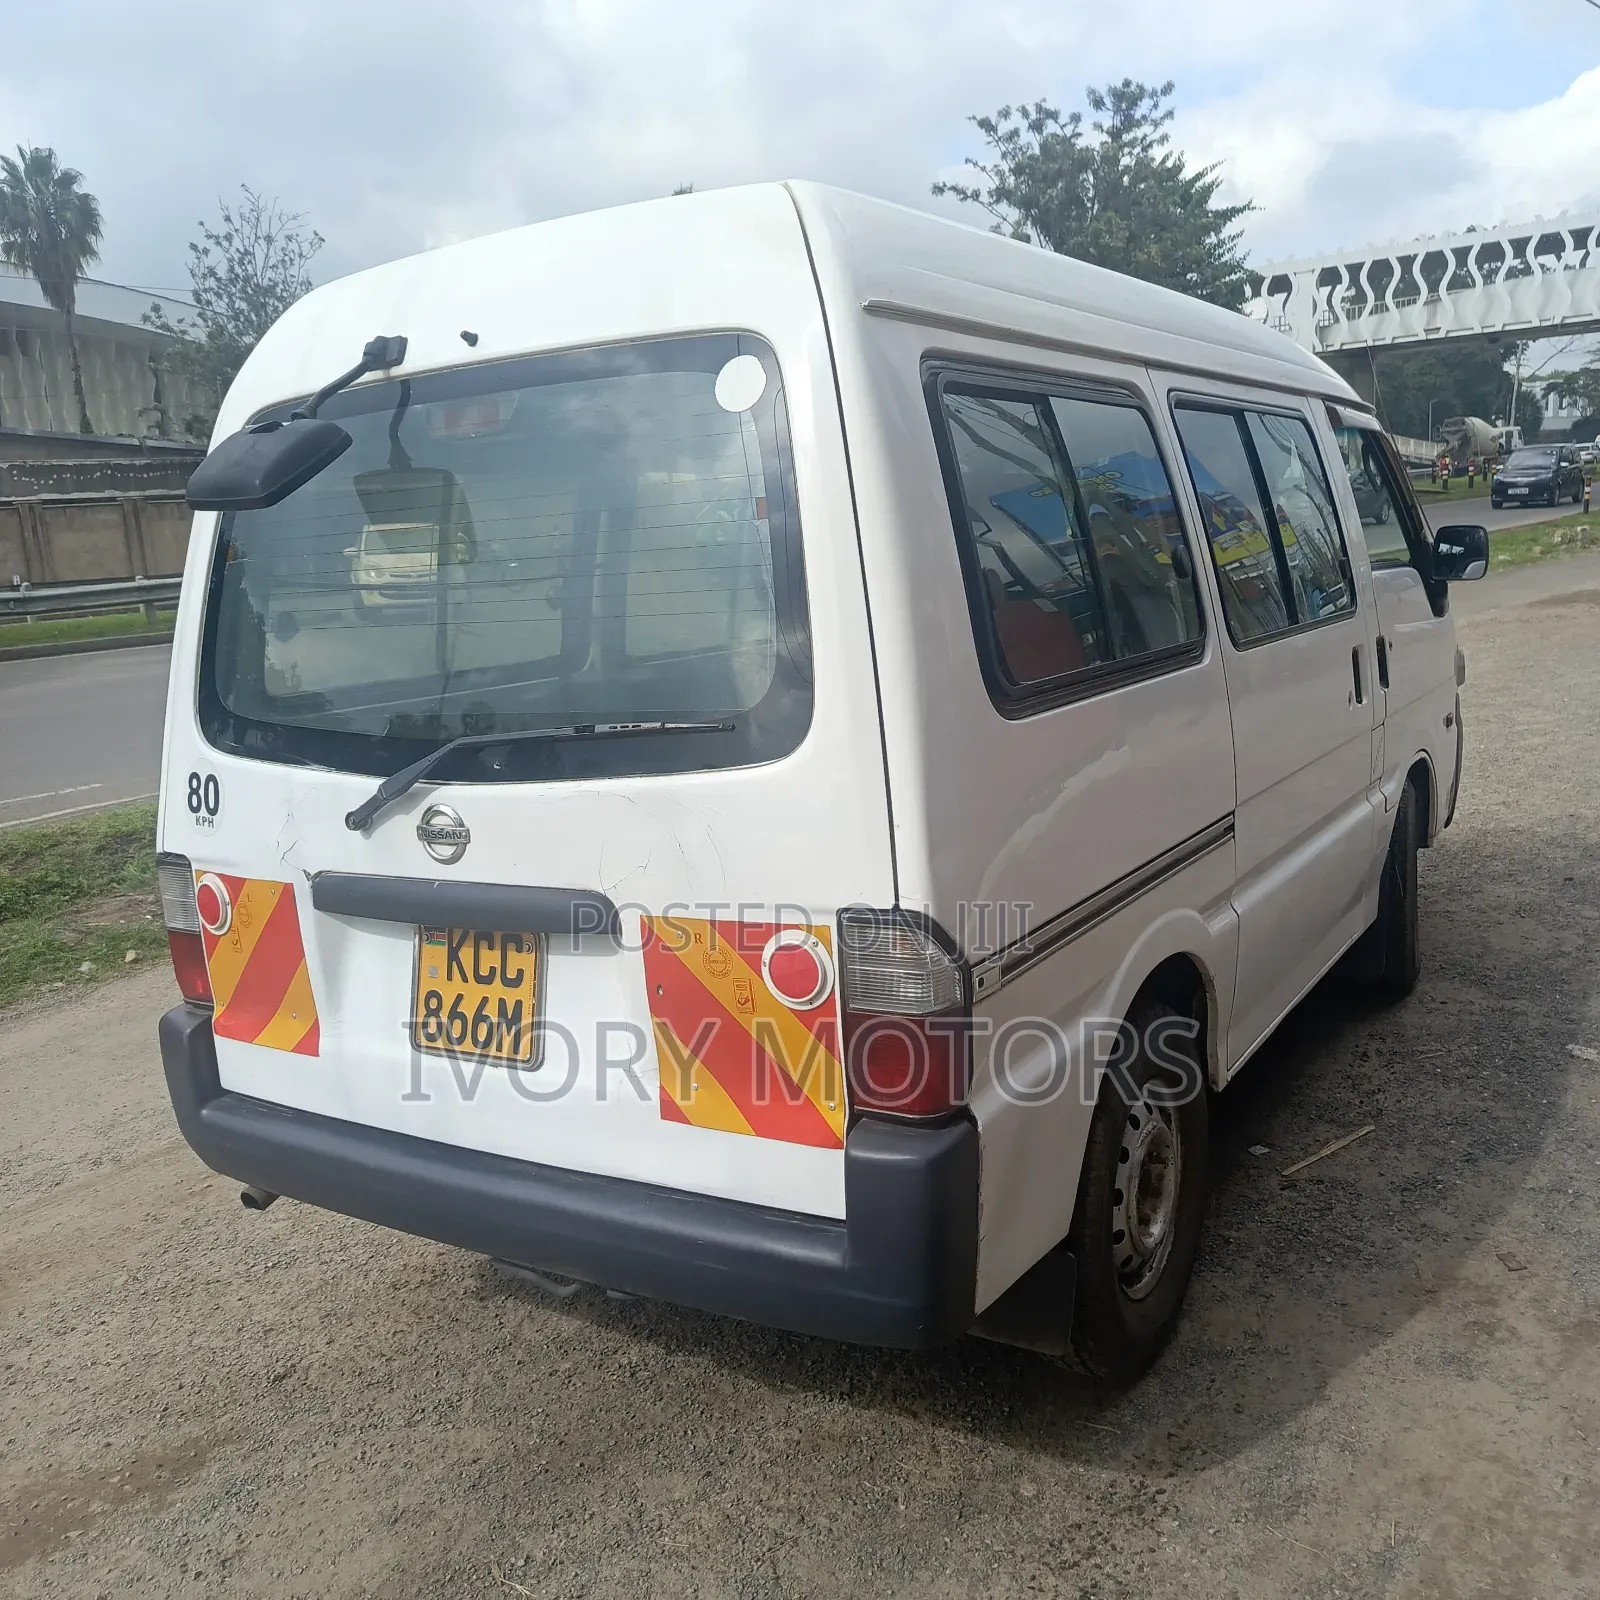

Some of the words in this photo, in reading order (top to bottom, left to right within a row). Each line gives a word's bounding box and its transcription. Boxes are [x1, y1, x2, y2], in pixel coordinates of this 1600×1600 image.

[188, 771, 220, 817] 80
[195, 815, 215, 829] KPH
[421, 829, 462, 840] NISSAN
[694, 932, 704, 945] R
[446, 929, 525, 988] KCC
[421, 989, 524, 1055] 866M
